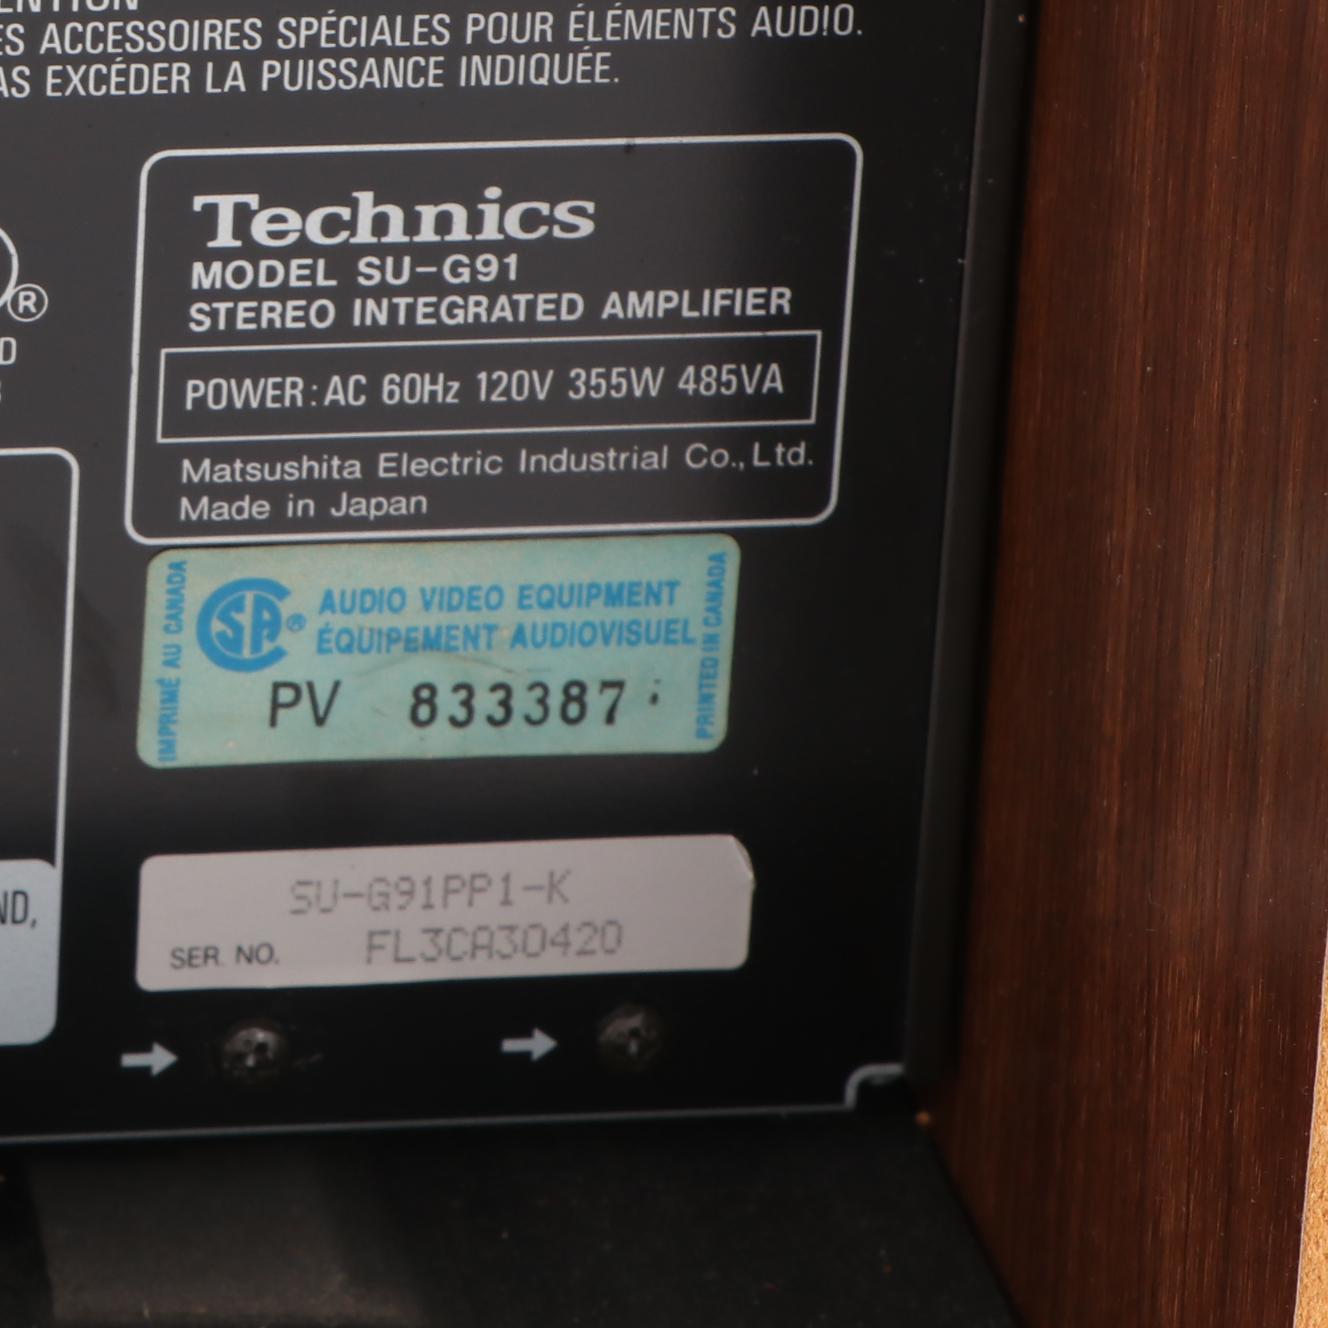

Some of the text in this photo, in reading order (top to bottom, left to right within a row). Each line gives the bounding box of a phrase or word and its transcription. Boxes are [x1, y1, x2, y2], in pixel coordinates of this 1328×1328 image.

[40, 18, 262, 54] ACCESSOIRES
[277, 10, 450, 49] SPÉCIALES
[466, 12, 553, 44] POUR
[569, 2, 736, 42] ÉLÉMENTS
[46, 57, 190, 96] EXCÉDER
[206, 61, 246, 93] LA
[262, 56, 444, 91] PUISSANCE
[460, 52, 618, 86] INDIQUÉE.
[193, 187, 594, 247] Technics
[192, 253, 517, 289] MODEL SU-G91
[189, 288, 790, 332] STEREO INTEGRATED AMPLIFIER
[382, 364, 782, 404] 60Hz 120V 355W 485VA
[182, 455, 361, 483] Matsushita
[378, 451, 502, 478] Electric
[520, 446, 668, 473] Industrial
[180, 492, 427, 521] Made in Japan
[318, 580, 681, 616] AUDIO VIDEO EQUIPMENT
[316, 617, 696, 655] ÉQUIPEMENT AUDIOVISUEL
[269, 680, 625, 728] PV 833387
[291, 869, 571, 915] SU-G91PP1-K
[236, 943, 278, 965] NO.
